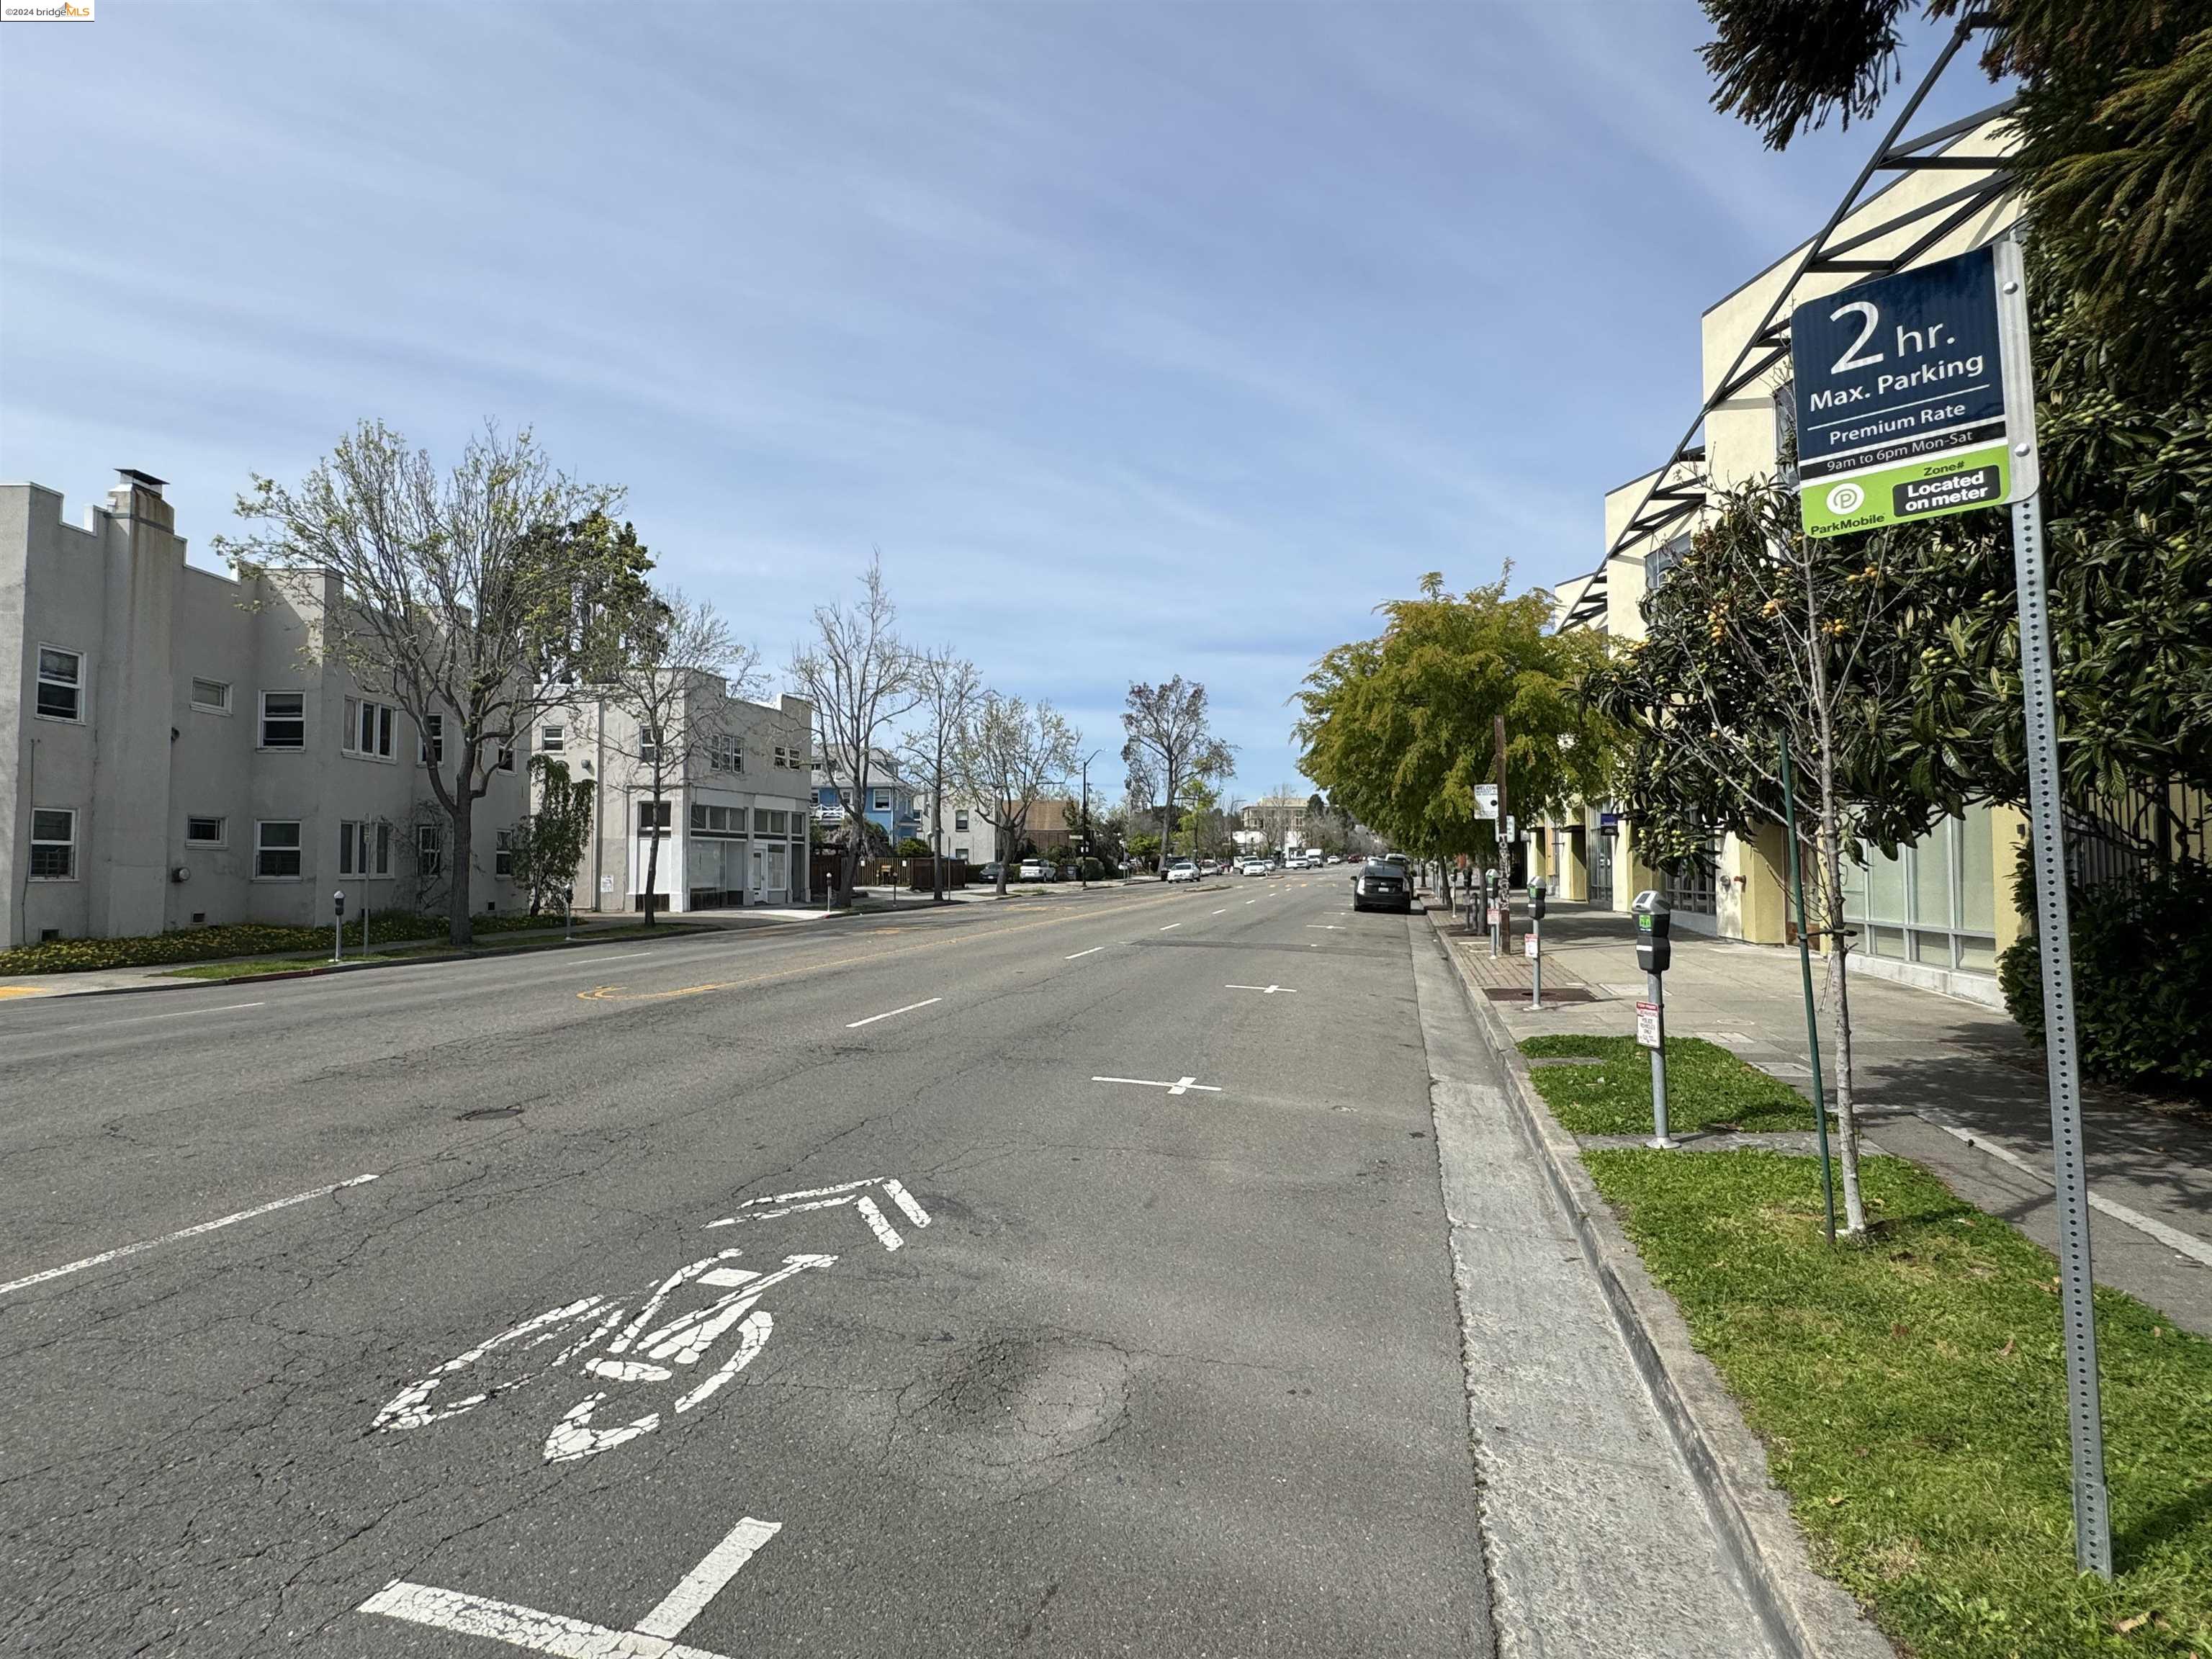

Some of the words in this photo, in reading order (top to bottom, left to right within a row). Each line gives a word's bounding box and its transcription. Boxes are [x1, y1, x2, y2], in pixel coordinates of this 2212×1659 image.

[1830, 301, 1884, 374] 2
[1896, 323, 1956, 358] hr.
[1809, 385, 1871, 413] Max.
[1877, 354, 1984, 395] Parking
[1830, 415, 1915, 446] Premium
[1920, 404, 1966, 425] Rate
[1827, 457, 1856, 472] 9am
[1860, 451, 1873, 465] to
[1876, 446, 1908, 463] 6pm
[1912, 431, 1973, 454] Mon-Sat
[1923, 460, 1965, 477] Zone#
[1905, 497, 1929, 512] on
[1931, 486, 1988, 507] meter
[1907, 470, 1984, 498] Located
[1810, 513, 1885, 536] ParkMobile
